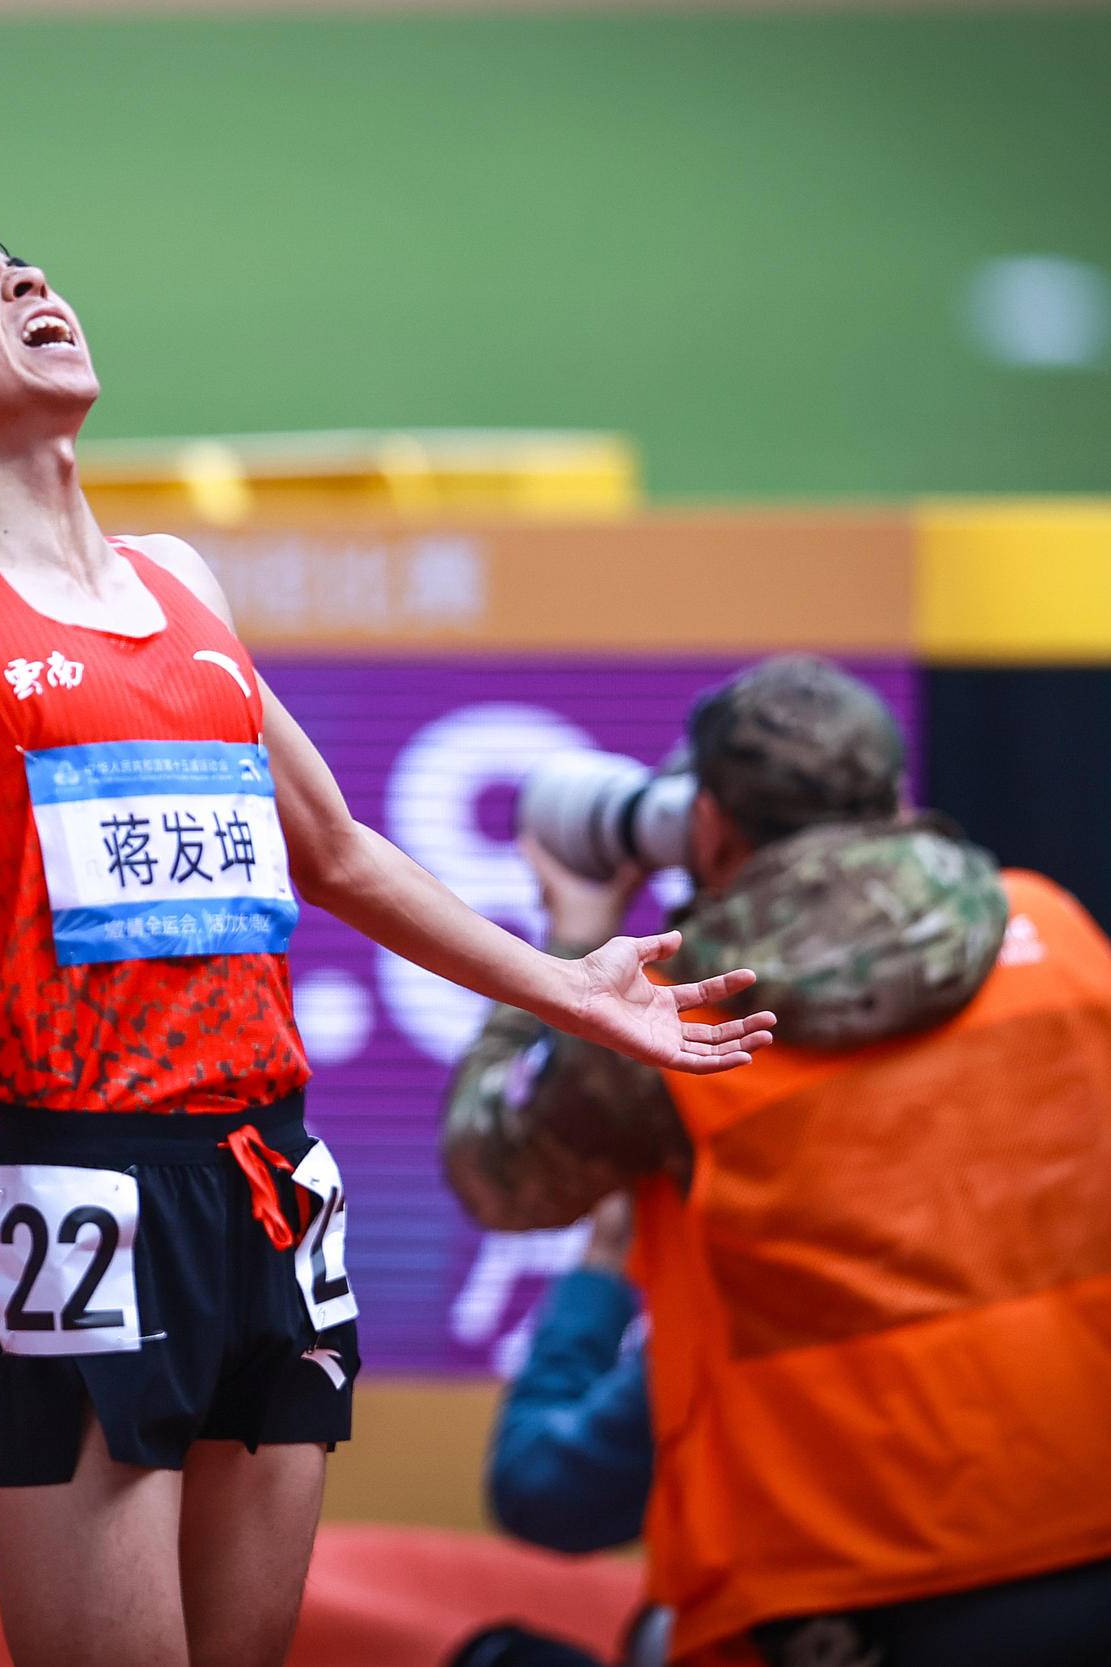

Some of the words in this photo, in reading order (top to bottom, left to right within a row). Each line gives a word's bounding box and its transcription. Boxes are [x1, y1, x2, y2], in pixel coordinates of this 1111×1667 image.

[3, 650, 85, 700] 雲南
[100, 810, 257, 887] 蒋发坤
[0, 1203, 125, 1331] 22
